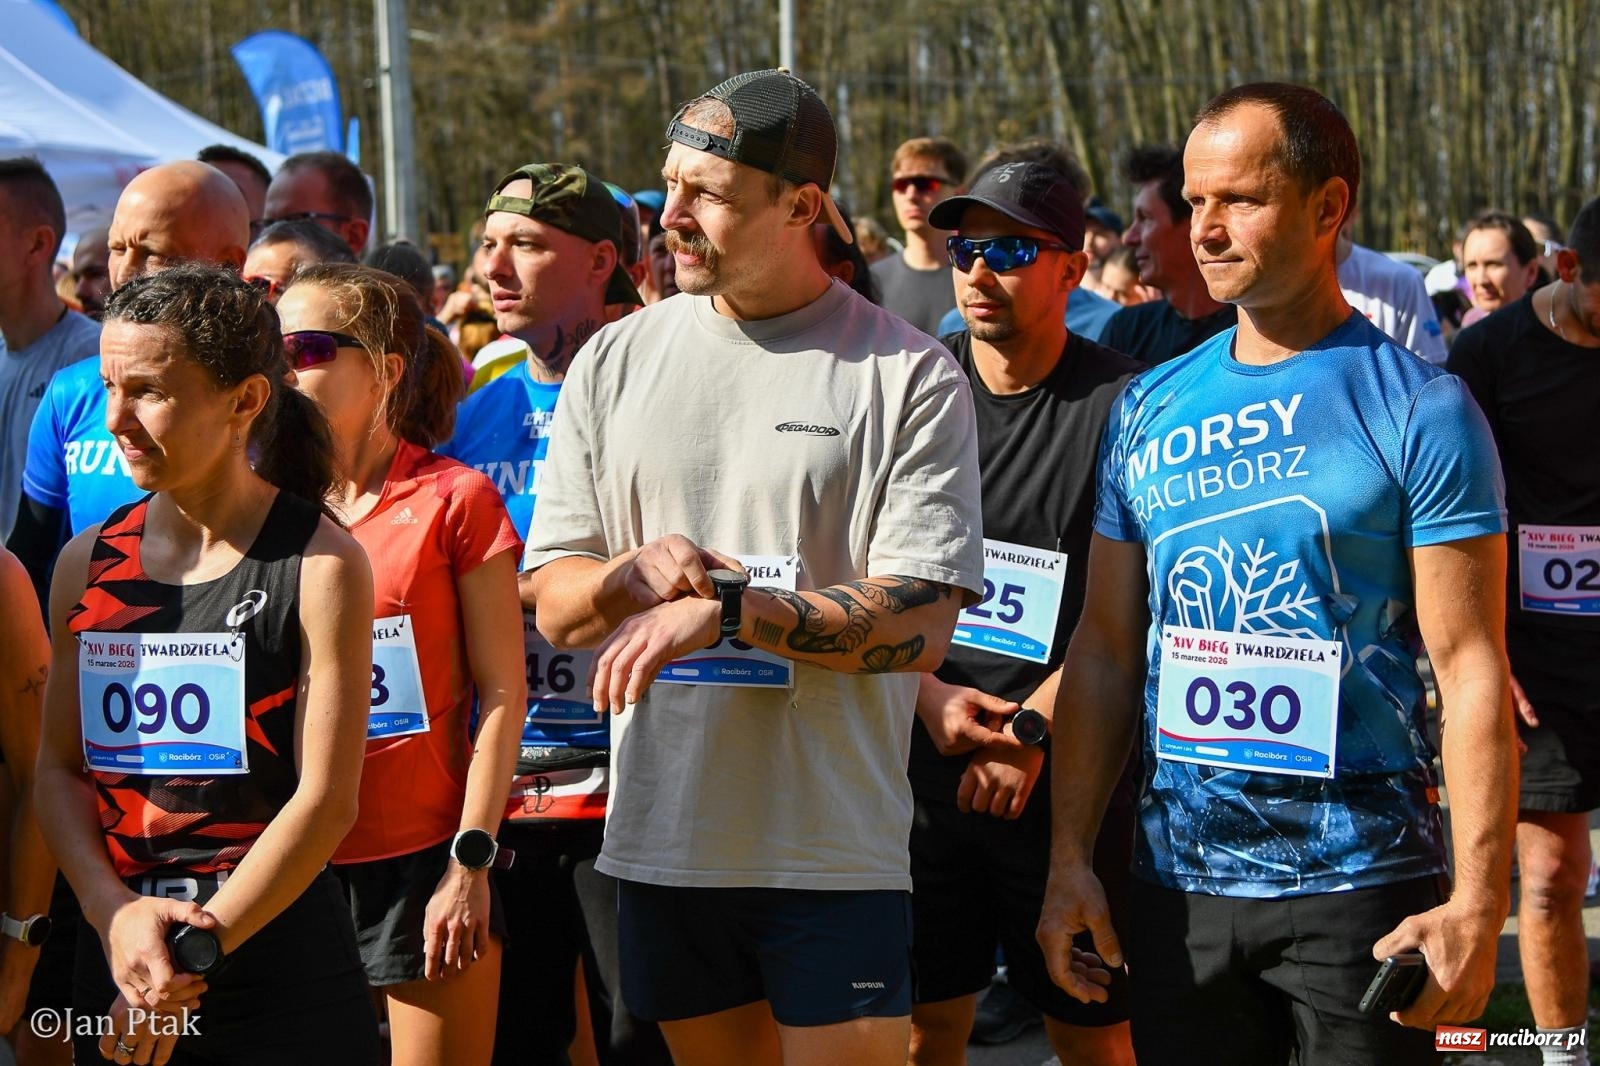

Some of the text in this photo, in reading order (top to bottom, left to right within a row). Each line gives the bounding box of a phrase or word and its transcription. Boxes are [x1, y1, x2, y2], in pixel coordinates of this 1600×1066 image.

[777, 423, 837, 436] PEGADOR
[1127, 393, 1304, 491] MORSY
[1130, 445, 1309, 528] RACIBÓRZ
[1528, 533, 1545, 541] XIV
[1549, 534, 1575, 543] BIEG
[984, 547, 1055, 570] TWARDZIELA
[1543, 557, 1600, 591] 02
[966, 578, 1026, 624] 25
[87, 643, 230, 657] XIV BIEG TWARDZIELA
[1173, 636, 1325, 662] XIV BIEG TWARDZIELA
[1180, 654, 1207, 663] marzec
[1208, 656, 1228, 665] 2026
[87, 659, 135, 668] 15 marzec 2026
[526, 653, 576, 693] 46
[721, 667, 752, 676] Racibórz
[102, 682, 211, 734] 090
[1185, 676, 1302, 734] 030
[169, 752, 202, 761] Racibórz
[1254, 749, 1288, 761] Racibórz
